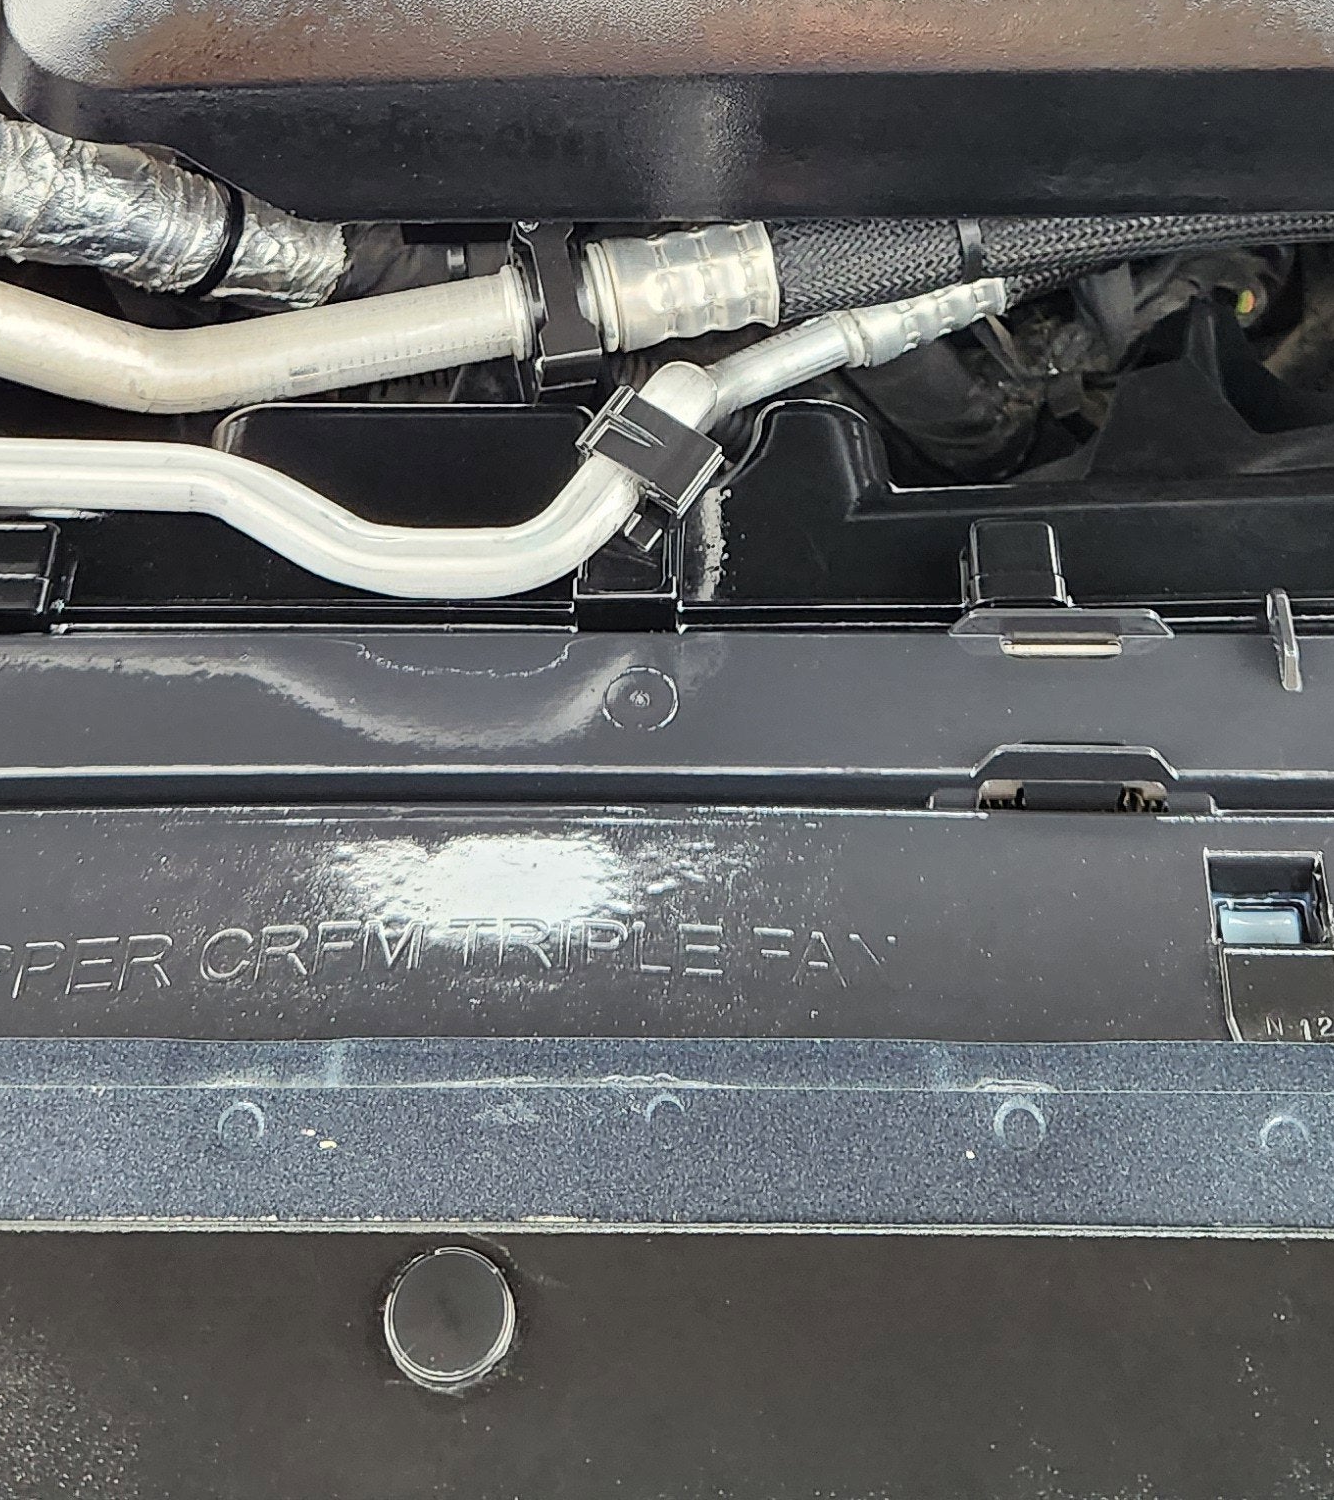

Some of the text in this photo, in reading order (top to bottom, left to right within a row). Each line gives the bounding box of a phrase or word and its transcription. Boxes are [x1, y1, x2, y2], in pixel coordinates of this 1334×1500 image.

[199, 917, 429, 983] CRFM
[449, 916, 725, 977] TRIPLE
[753, 926, 898, 989] FAN
